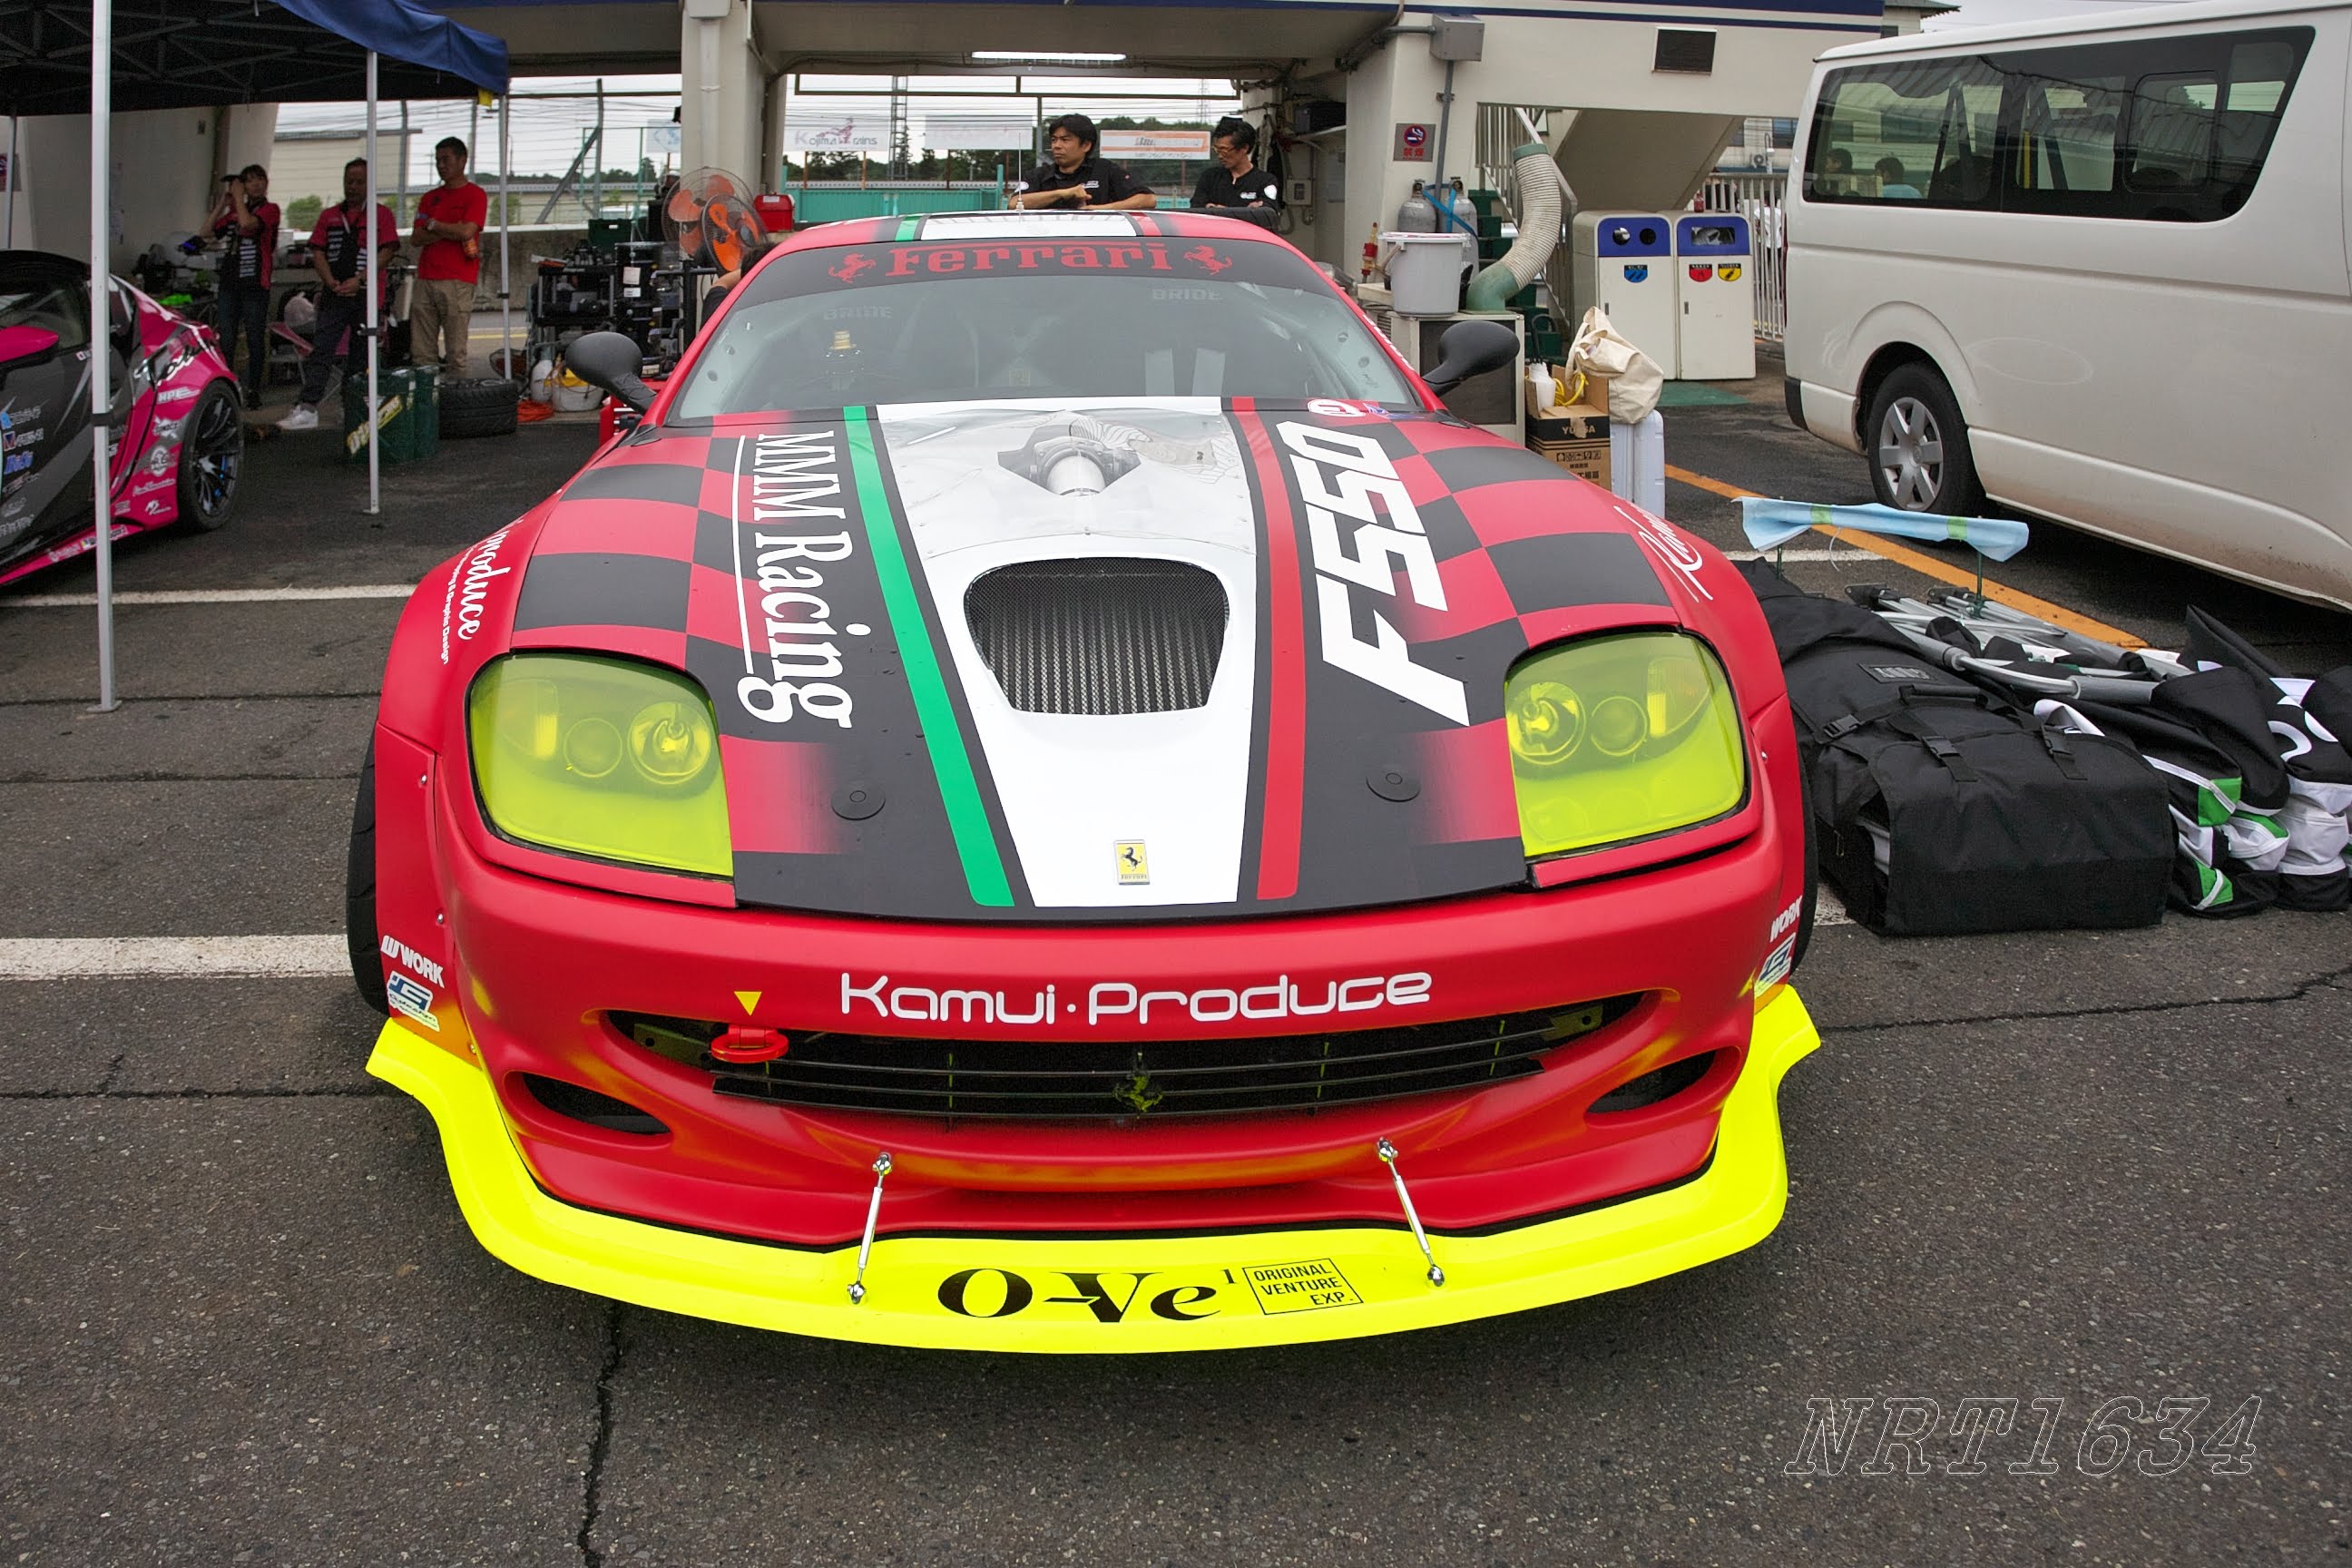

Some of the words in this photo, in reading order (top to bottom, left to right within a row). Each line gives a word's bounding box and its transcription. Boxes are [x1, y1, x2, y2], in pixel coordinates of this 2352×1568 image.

[886, 242, 1172, 278] Ferrari
[754, 429, 847, 519] MMM
[1276, 420, 1470, 727] F550
[737, 532, 872, 729] Racing
[1769, 895, 1802, 943] WORK
[399, 943, 445, 988] WORK
[1253, 1263, 1333, 1282] ORIGINAL
[1260, 1277, 1343, 1297] VENTURE
